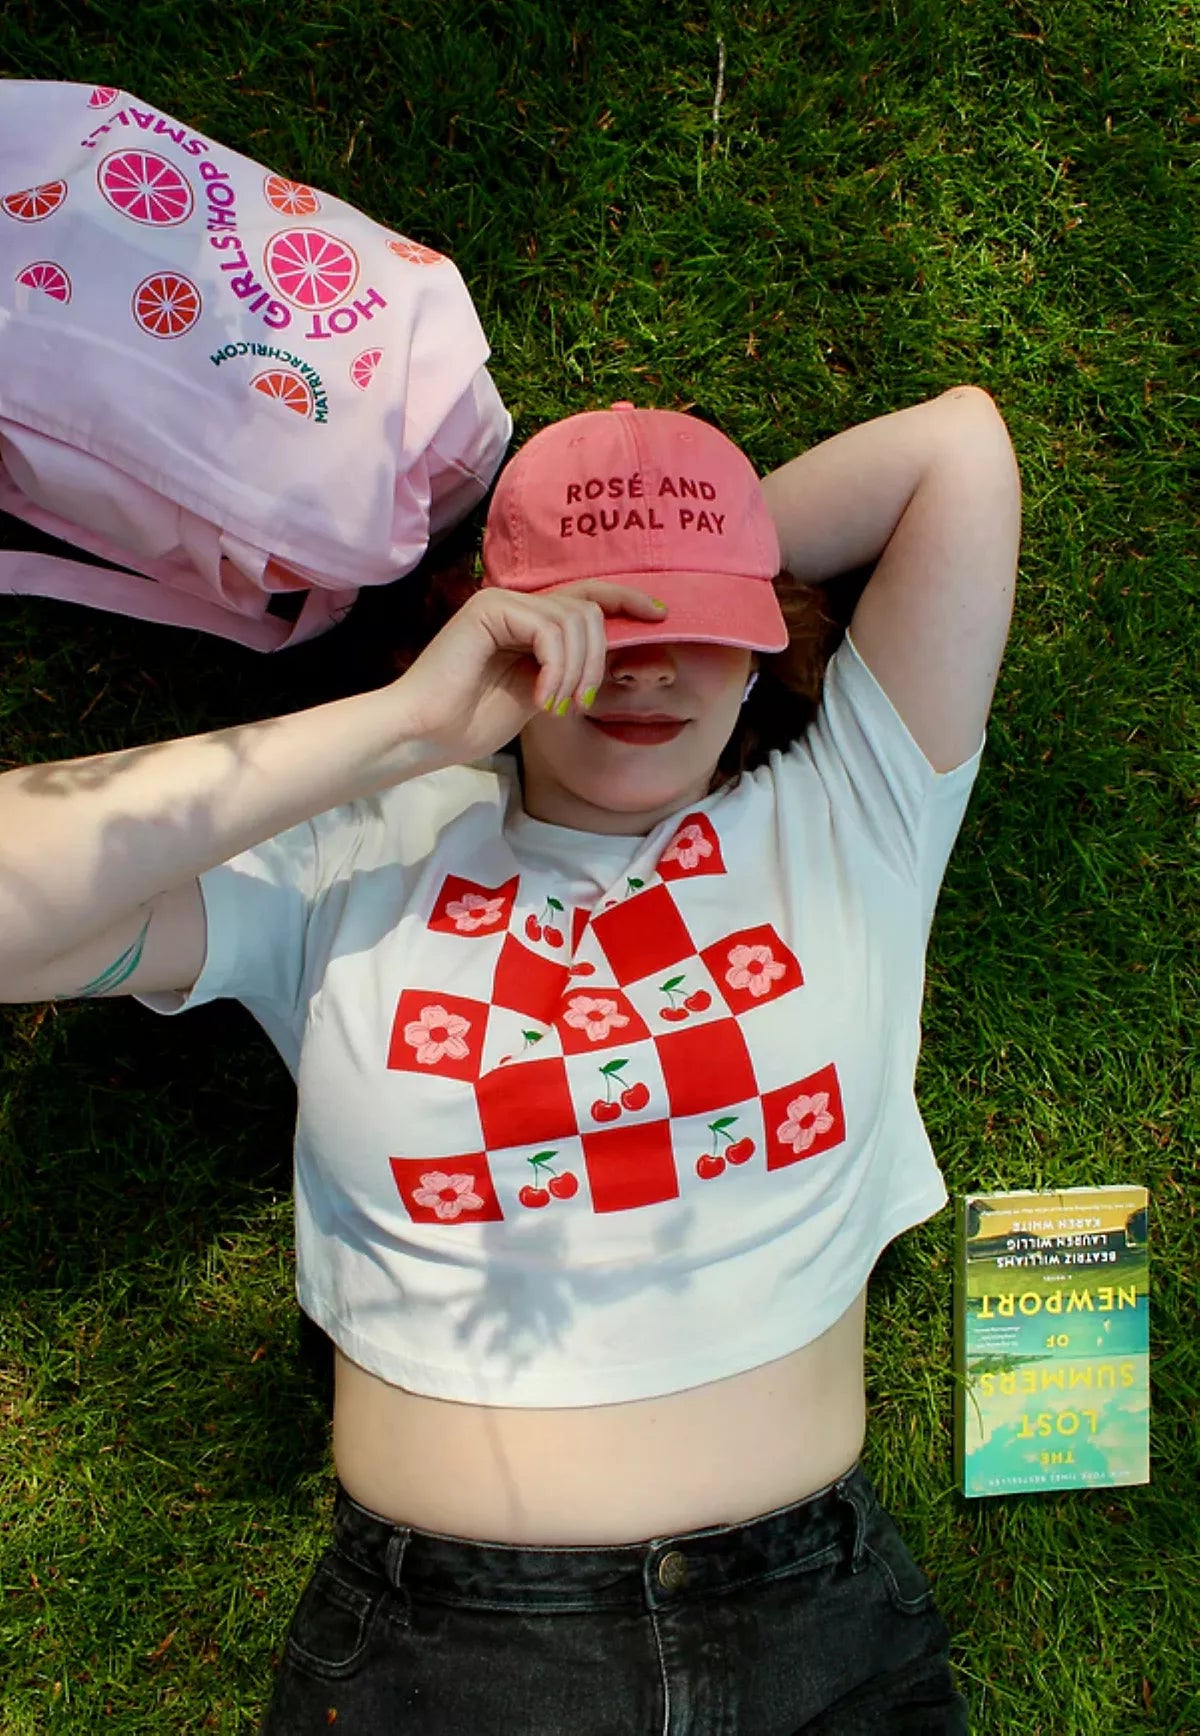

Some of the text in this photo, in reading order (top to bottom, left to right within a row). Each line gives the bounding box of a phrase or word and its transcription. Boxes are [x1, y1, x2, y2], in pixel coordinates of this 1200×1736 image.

[210, 236, 291, 329] GIRLS
[305, 288, 387, 340] HOT
[567, 472, 716, 504] ROSÉ AND
[560, 509, 726, 537] EQUAL PAY
[1012, 1217, 1101, 1232] KAREN WHITE
[1007, 1235, 1107, 1250] LAUREN WILLIG
[997, 1251, 1117, 1268] BEATRIZ WILLIAMS
[977, 1285, 1136, 1319] NEWPORT
[1046, 1334, 1069, 1347] OF
[980, 1363, 1136, 1397] SUMMERS
[1017, 1409, 1098, 1439] LOST
[1040, 1452, 1074, 1465] THE
